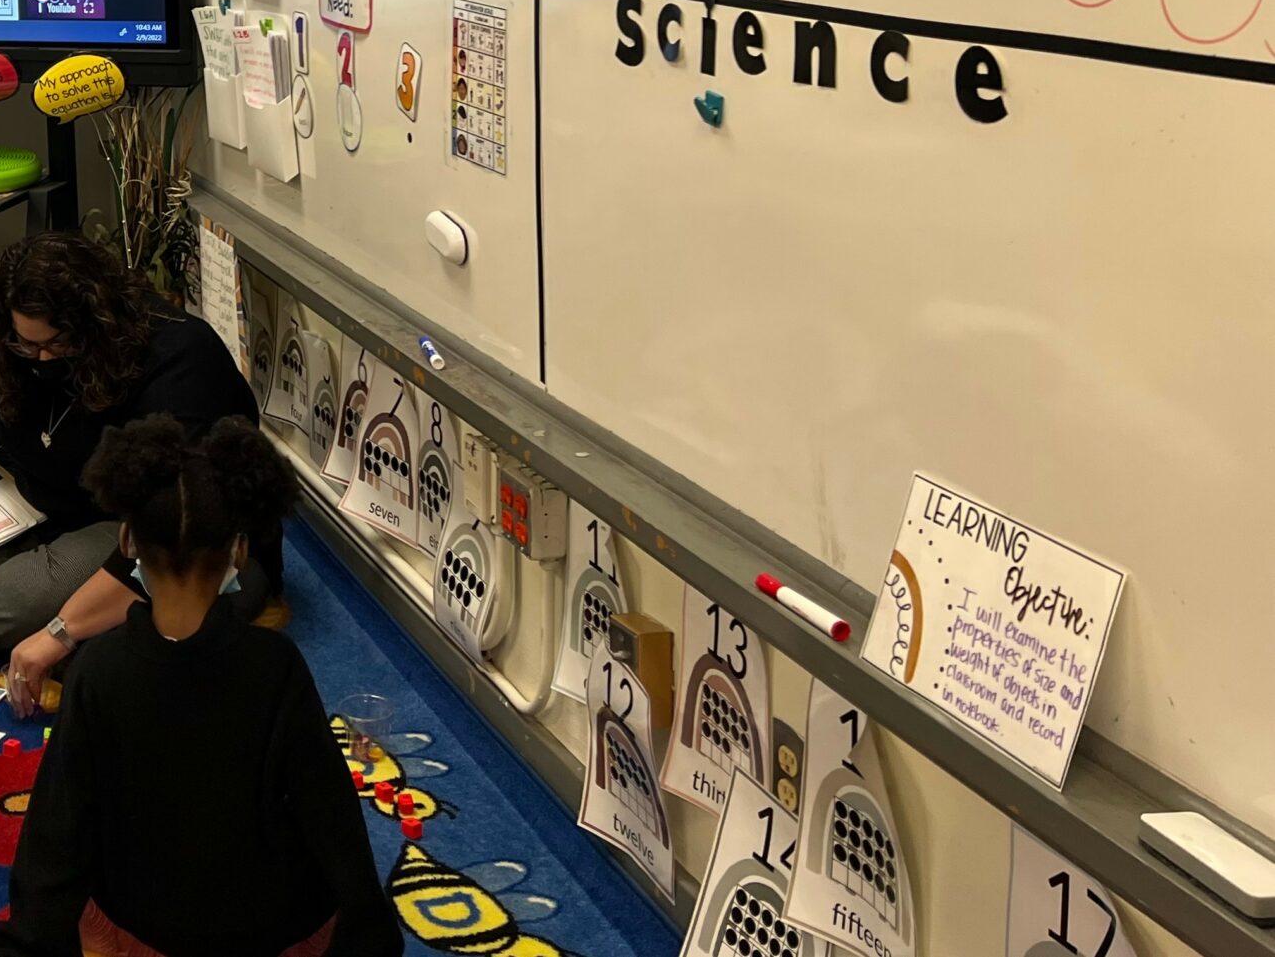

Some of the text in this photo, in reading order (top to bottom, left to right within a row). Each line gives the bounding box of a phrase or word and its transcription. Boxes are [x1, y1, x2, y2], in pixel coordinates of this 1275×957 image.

[38, 61, 113, 91] My approach
[337, 32, 353, 88] 2
[397, 51, 417, 111] 3
[45, 76, 116, 102] to solve this
[431, 401, 443, 448] 8
[368, 501, 401, 528] seven
[923, 488, 1030, 563] LEARNING
[705, 603, 748, 680] 13
[951, 615, 1022, 668] properties
[1022, 656, 1037, 678] of
[1059, 686, 1084, 712] and
[956, 587, 1088, 684] I will examine the
[602, 662, 637, 740] 12
[1000, 699, 1066, 750] and record
[612, 811, 656, 867] twelve
